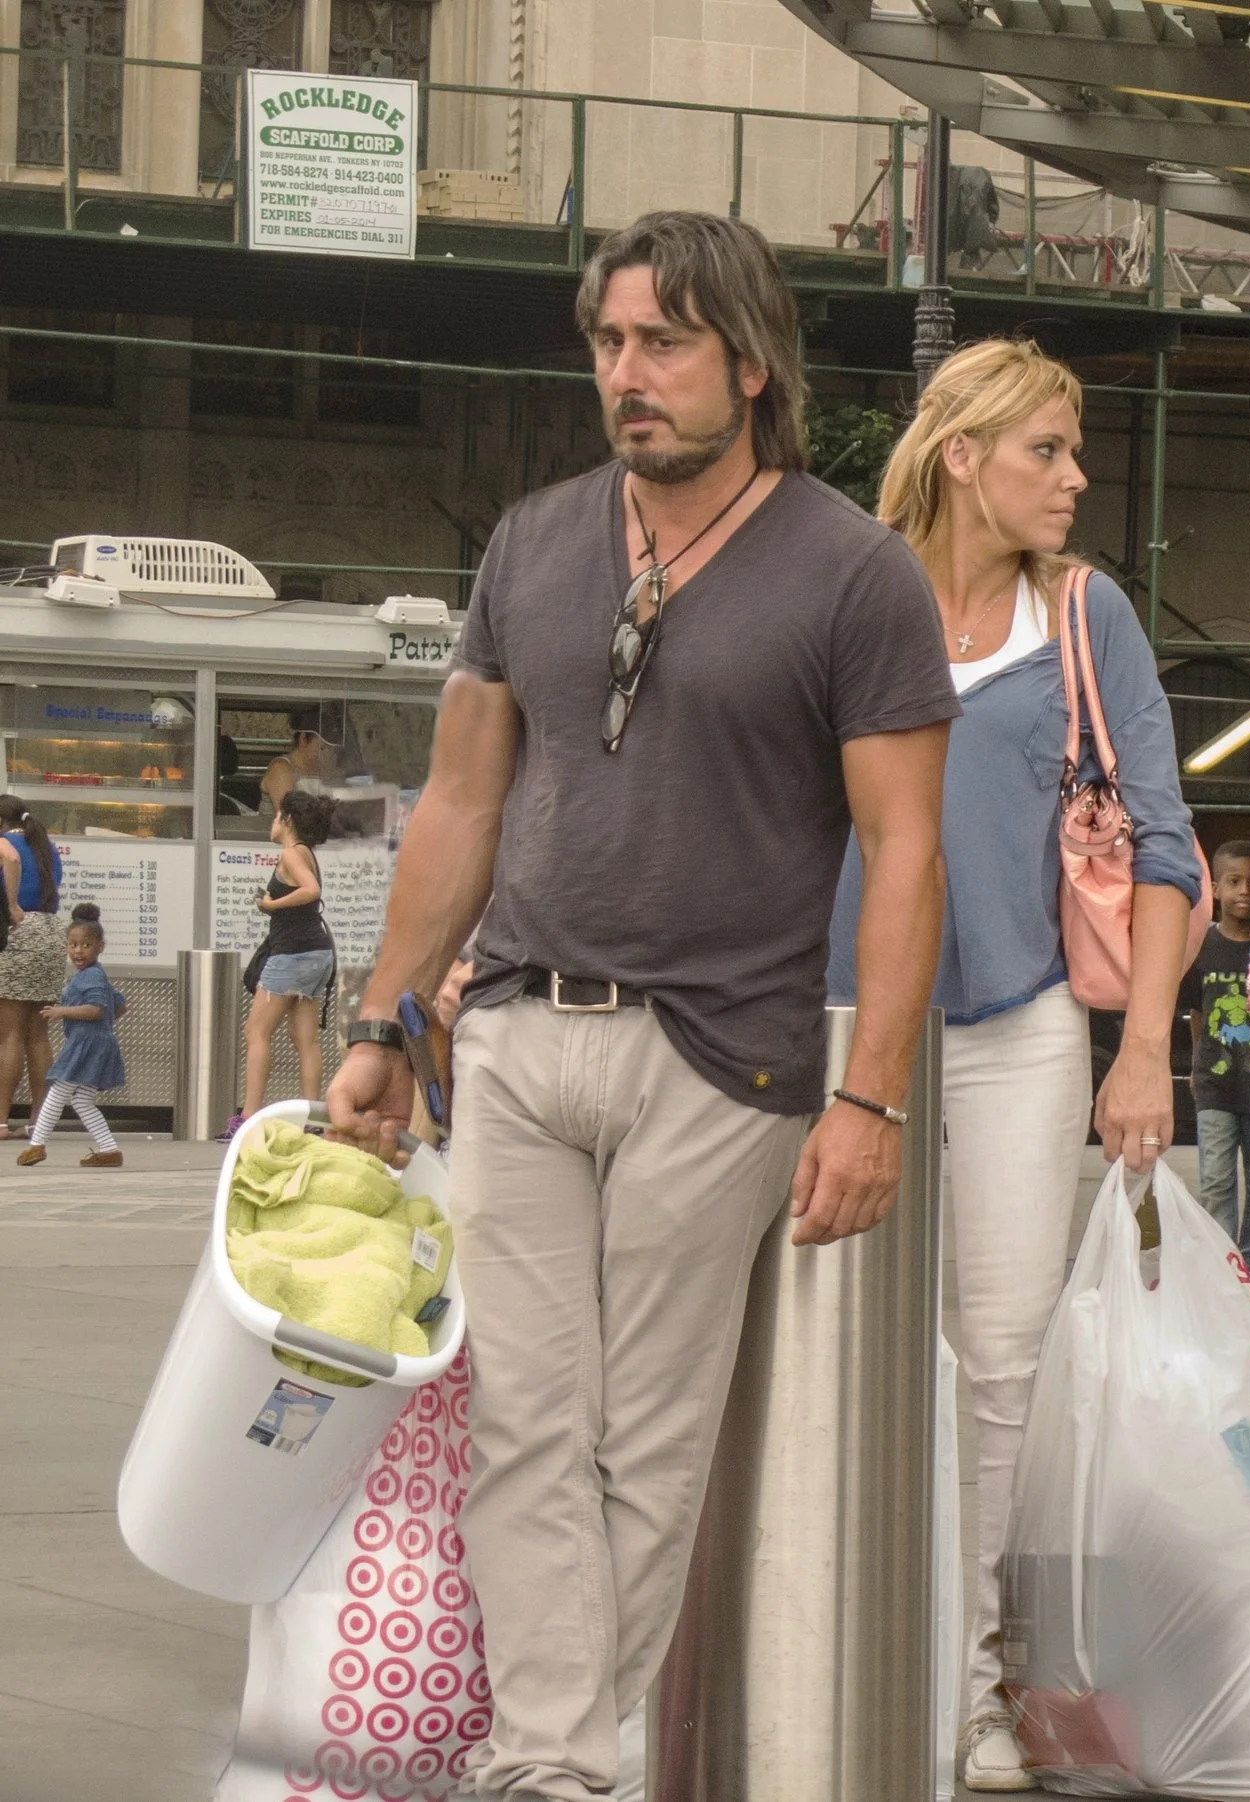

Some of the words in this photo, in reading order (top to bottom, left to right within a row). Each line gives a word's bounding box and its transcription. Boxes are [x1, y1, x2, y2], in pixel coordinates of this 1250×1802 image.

[260, 87, 406, 131] ROCKLEDGE
[270, 129, 349, 149] SCAFFOLD
[353, 135, 400, 153] CORP.
[337, 156, 370, 166] YONKERS
[372, 159, 381, 167] NY
[260, 164, 328, 179] 718-584-8274
[334, 169, 404, 184] 914-423-0400
[260, 180, 405, 198] www.rockledgescaffold.com
[260, 192, 318, 208] PERMIT#
[260, 208, 312, 222] EXPIRES
[260, 225, 281, 235] FOR
[284, 226, 358, 241] EMERGENCIES
[361, 231, 385, 243] DIAL
[388, 234, 404, 244] 311
[389, 632, 453, 660] Patat
[80, 870, 106, 878] Cheese
[217, 875, 230, 883] Fish
[80, 882, 106, 890] Cheese
[216, 886, 230, 894] Fish
[70, 892, 96, 900] Cheese
[216, 897, 230, 905] Fish
[216, 908, 230, 916] Fish
[216, 942, 232, 950] Beef
[234, 942, 252, 950] Over
[1204, 972, 1249, 985] HUL
